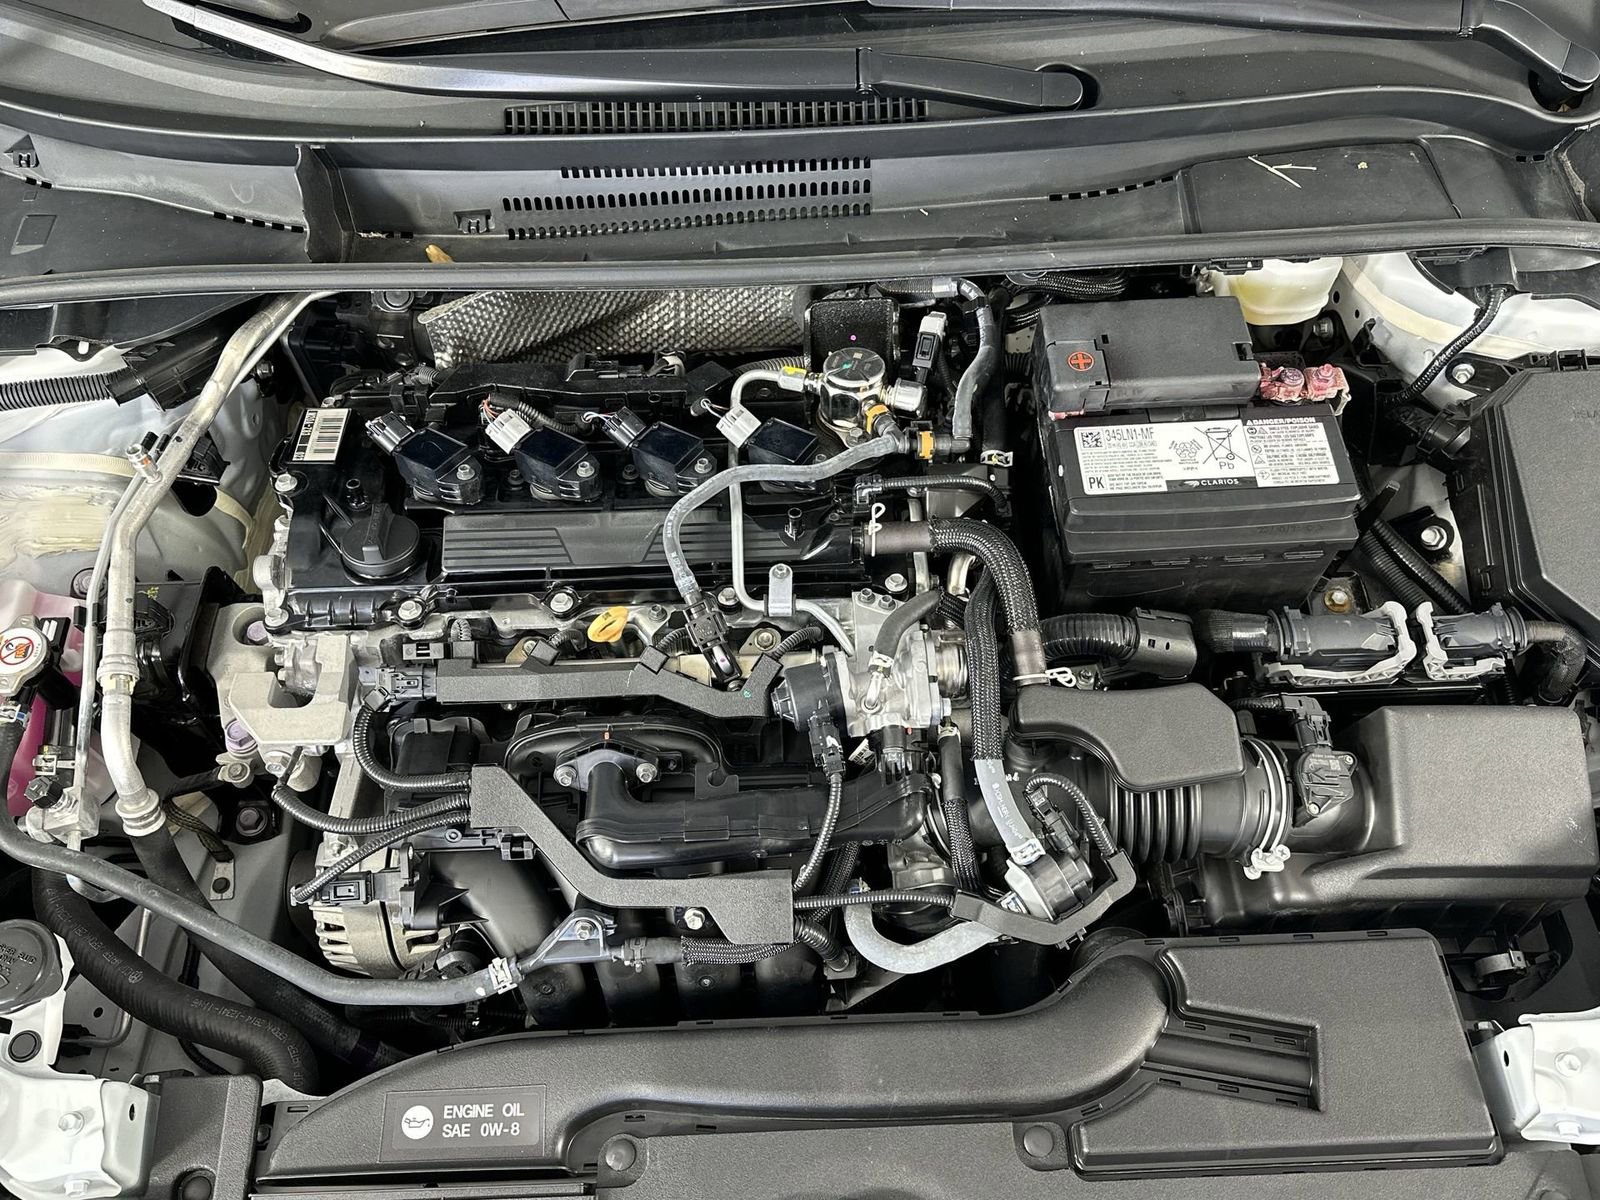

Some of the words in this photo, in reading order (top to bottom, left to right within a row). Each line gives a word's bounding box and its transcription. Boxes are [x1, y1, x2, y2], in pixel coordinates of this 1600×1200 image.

[1252, 416, 1316, 425] DANGER/POISON
[1104, 426, 1154, 441] 345LN1-MF
[1218, 461, 1235, 470] Pb
[1088, 476, 1105, 489] PK
[1200, 478, 1239, 486] CLARIOS
[443, 1103, 494, 1119] ENGINE
[502, 1102, 525, 1117] OIL
[441, 1123, 471, 1138] SAE
[480, 1121, 520, 1137] 0W-8
